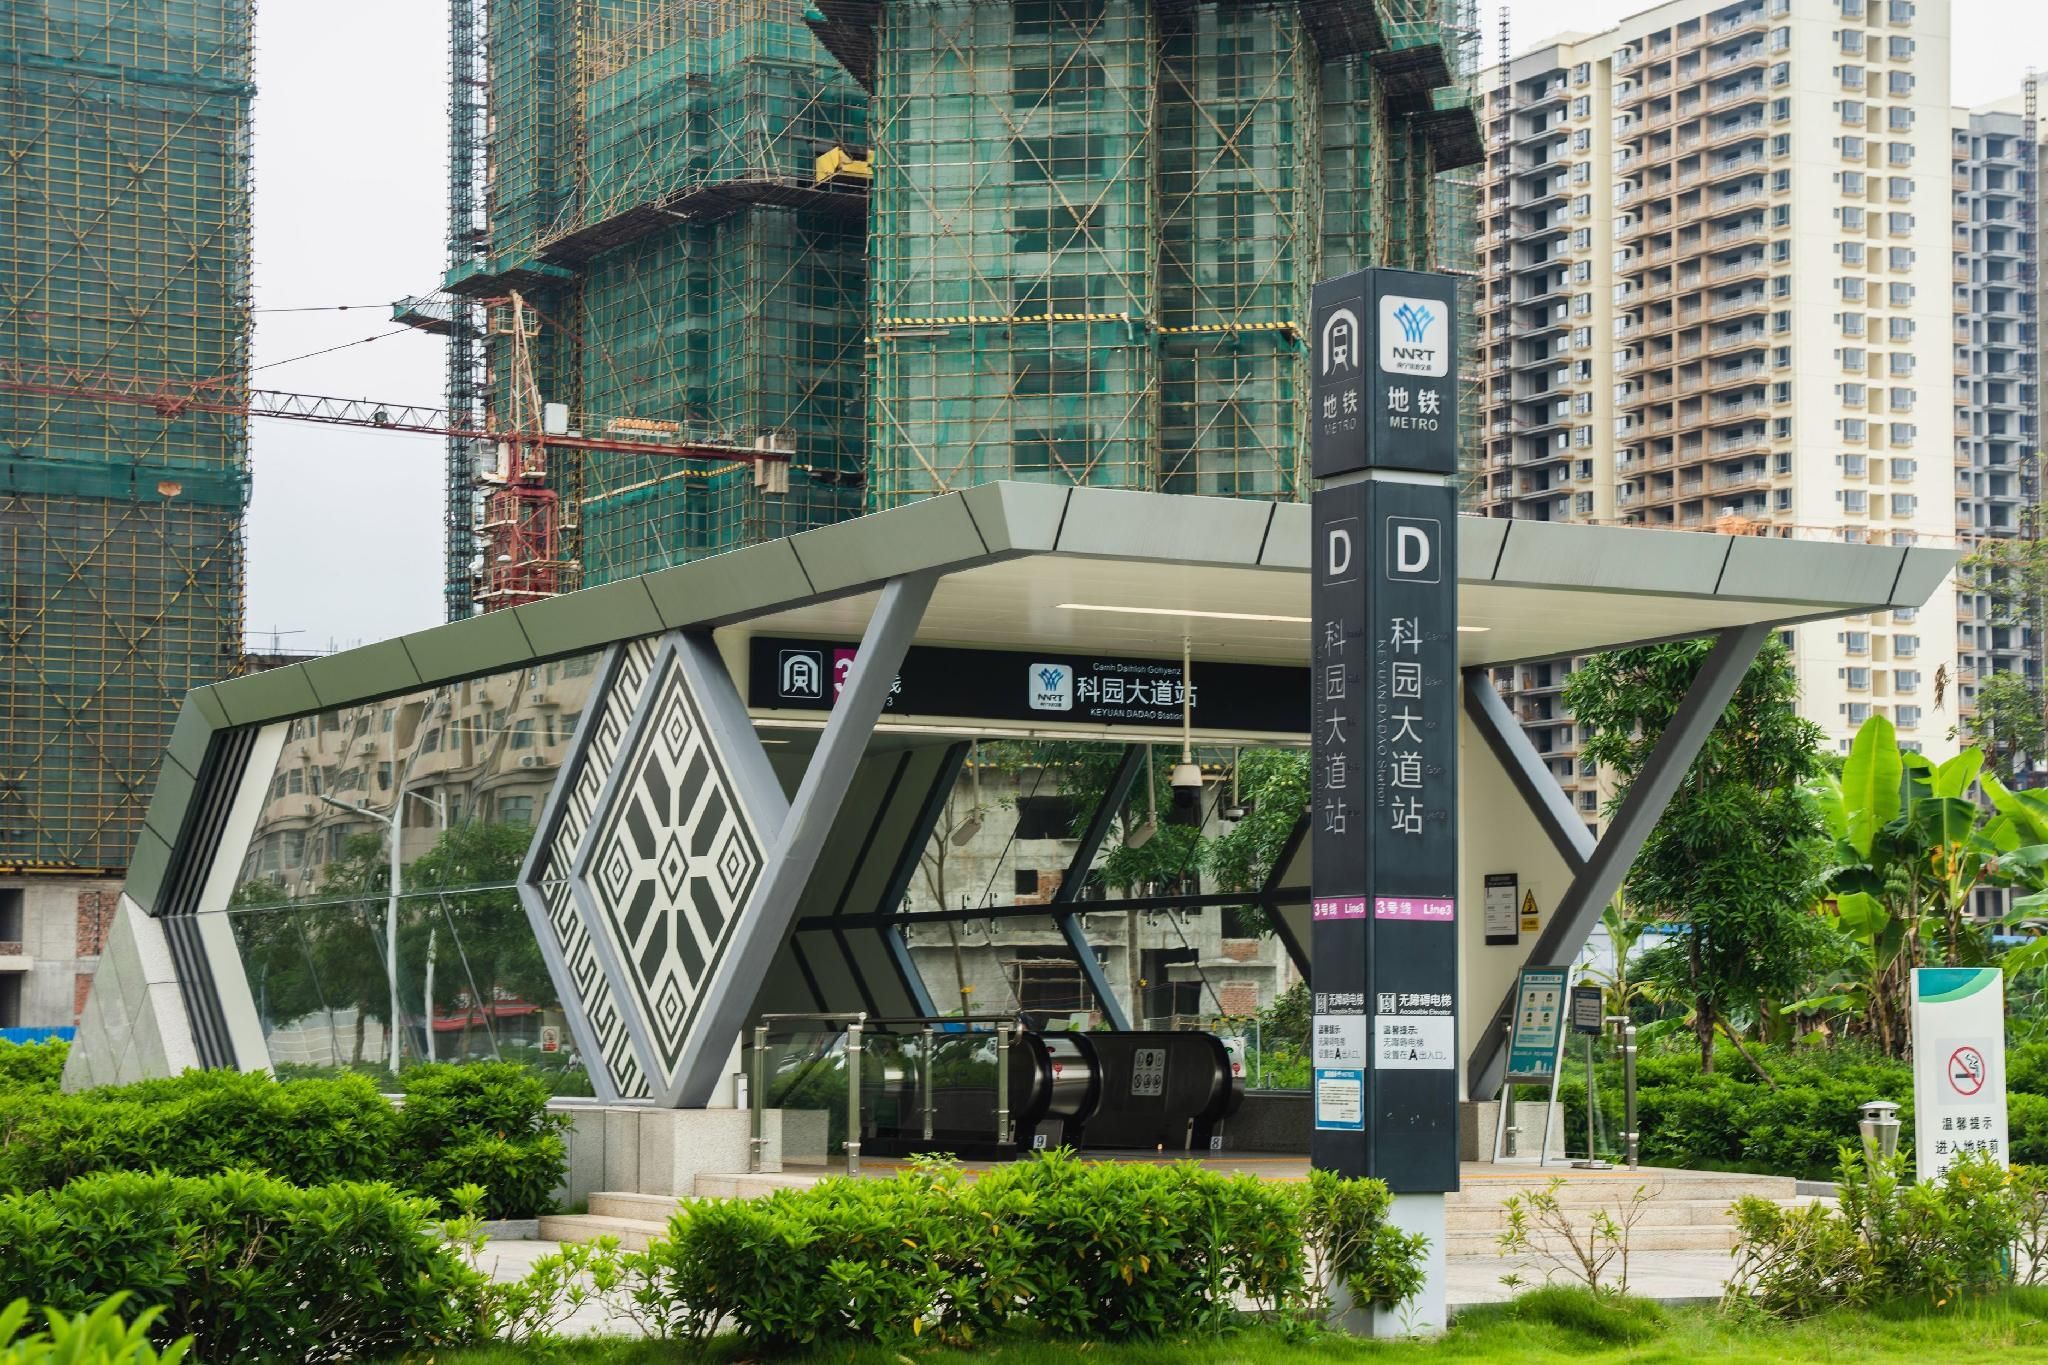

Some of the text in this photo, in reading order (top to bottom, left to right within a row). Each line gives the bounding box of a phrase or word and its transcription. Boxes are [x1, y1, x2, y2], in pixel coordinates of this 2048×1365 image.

[1393, 347, 1435, 361] NNRT
[1323, 388, 1357, 419] 地铁
[1388, 386, 1440, 415] 地铁
[1324, 417, 1357, 436] METRO
[1390, 416, 1438, 431] METRO
[1329, 529, 1351, 575] D
[1397, 526, 1430, 573] D
[1076, 675, 1198, 708] 科园大道站
[1090, 708, 1184, 720] KEYUAN DADAO Station
[1324, 618, 1347, 834] 科园大道站
[1377, 703, 1388, 756] DADAO
[1390, 616, 1423, 834] 科园大道站
[1377, 760, 1387, 807] Station
[1314, 902, 1364, 916] 3号线 Line3
[1377, 901, 1452, 915] 3号线 Line3
[1398, 993, 1452, 1007] 无障碍电梯
[1942, 1116, 1992, 1130] 温馨提示
[1036, 1136, 1044, 1147] 9
[1211, 1137, 1219, 1149] 8
